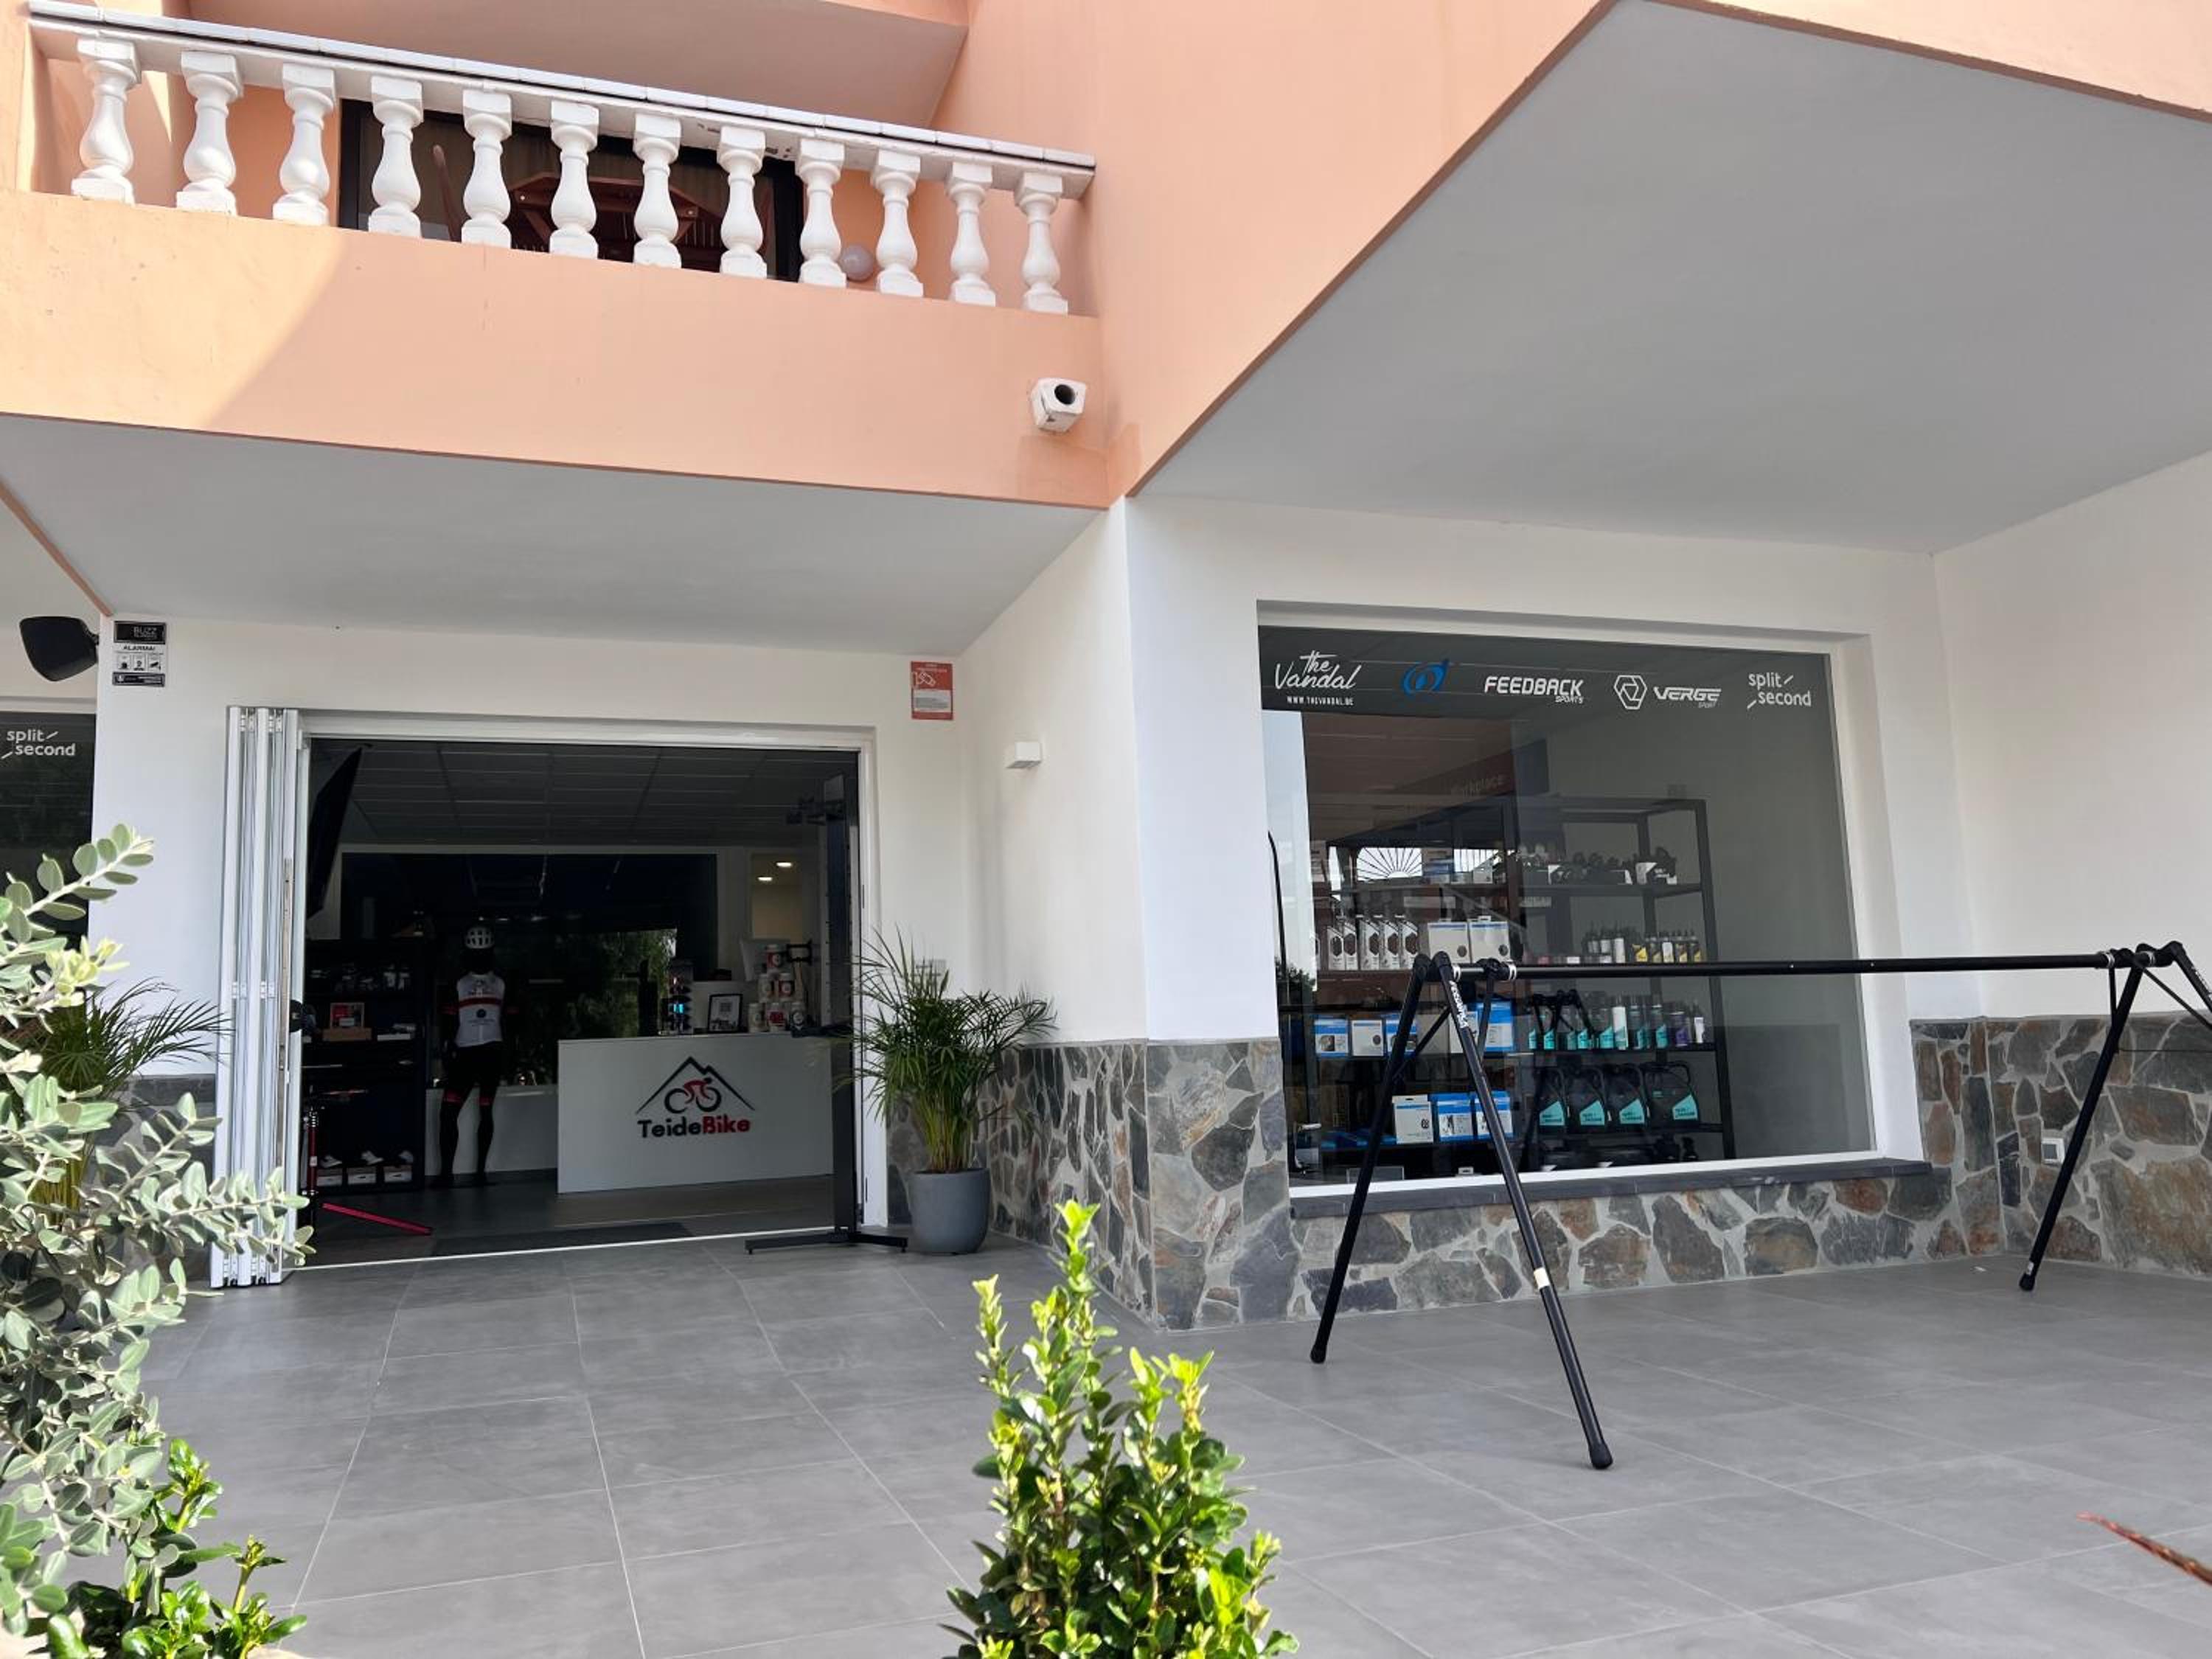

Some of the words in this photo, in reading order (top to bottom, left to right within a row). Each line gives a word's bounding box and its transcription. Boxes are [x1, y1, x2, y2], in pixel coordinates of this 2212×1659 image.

[1275, 661, 1363, 689] Vandal
[1748, 672, 1782, 690] split
[1484, 675, 1585, 696] FEEDBACK
[1653, 686, 1722, 701] VERGE
[1554, 696, 1584, 704] SPORTS
[1758, 690, 1811, 706] second
[7, 728, 45, 744] split
[15, 743, 76, 757] second
[637, 1114, 751, 1138] TeideBike
